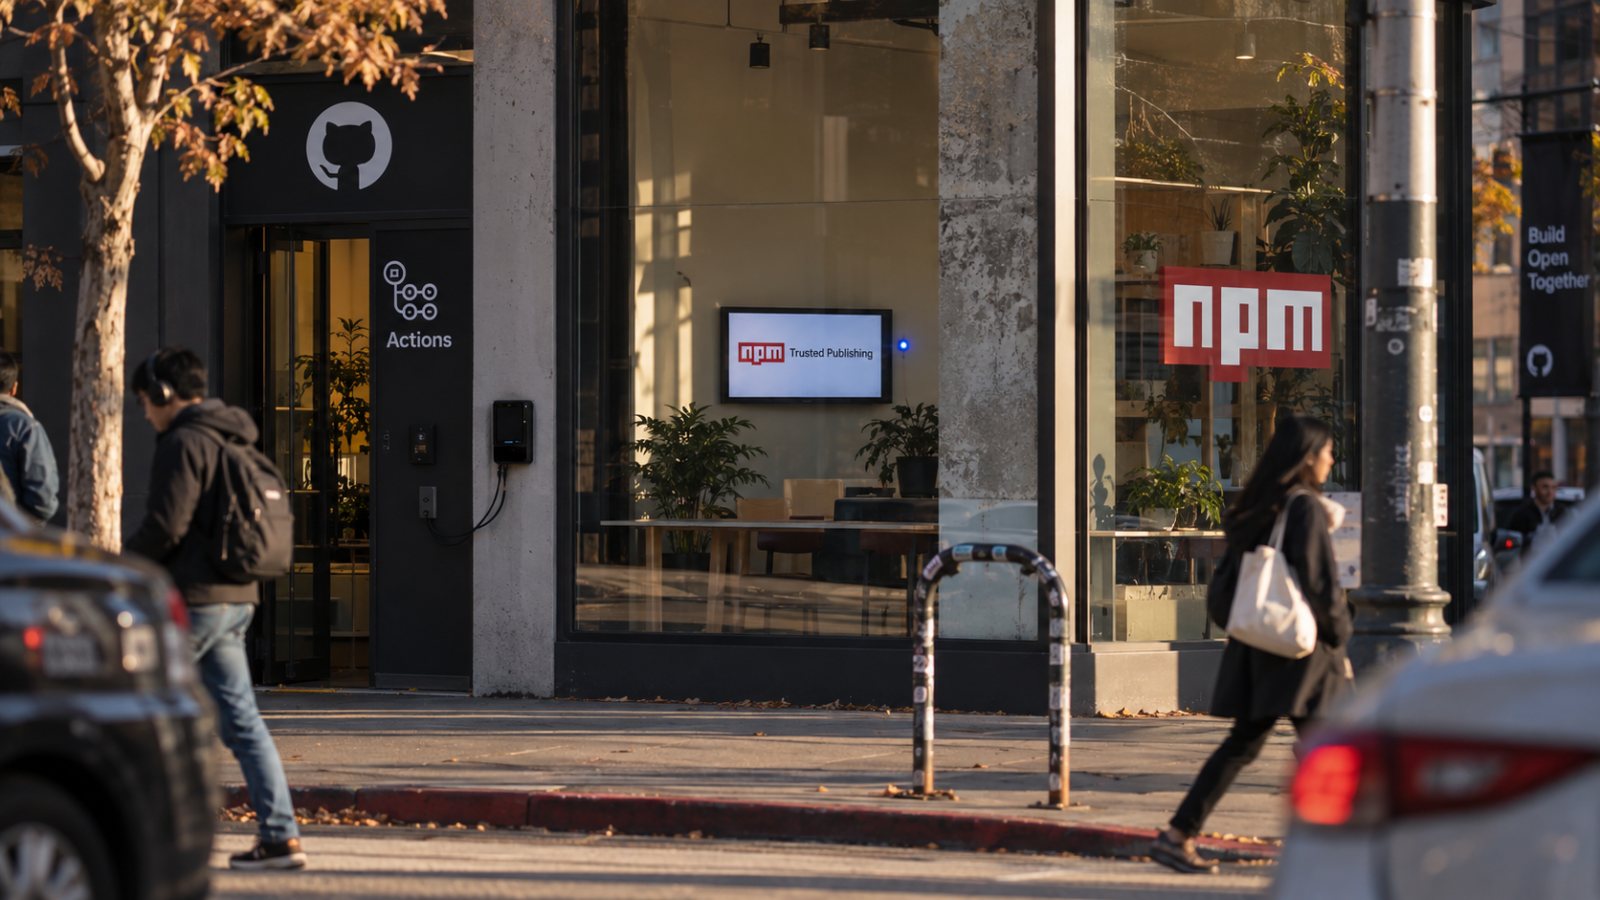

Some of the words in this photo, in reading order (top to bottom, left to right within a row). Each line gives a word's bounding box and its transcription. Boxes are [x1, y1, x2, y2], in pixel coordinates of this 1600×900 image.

[1528, 225, 1565, 244] Build
[1528, 249, 1569, 270] Open
[1528, 271, 1590, 294] Together
[1173, 284, 1323, 366] npm
[386, 331, 452, 348] Actions
[741, 345, 783, 363] npm
[789, 348, 824, 358] Trusted
[827, 348, 873, 360] Publishing
